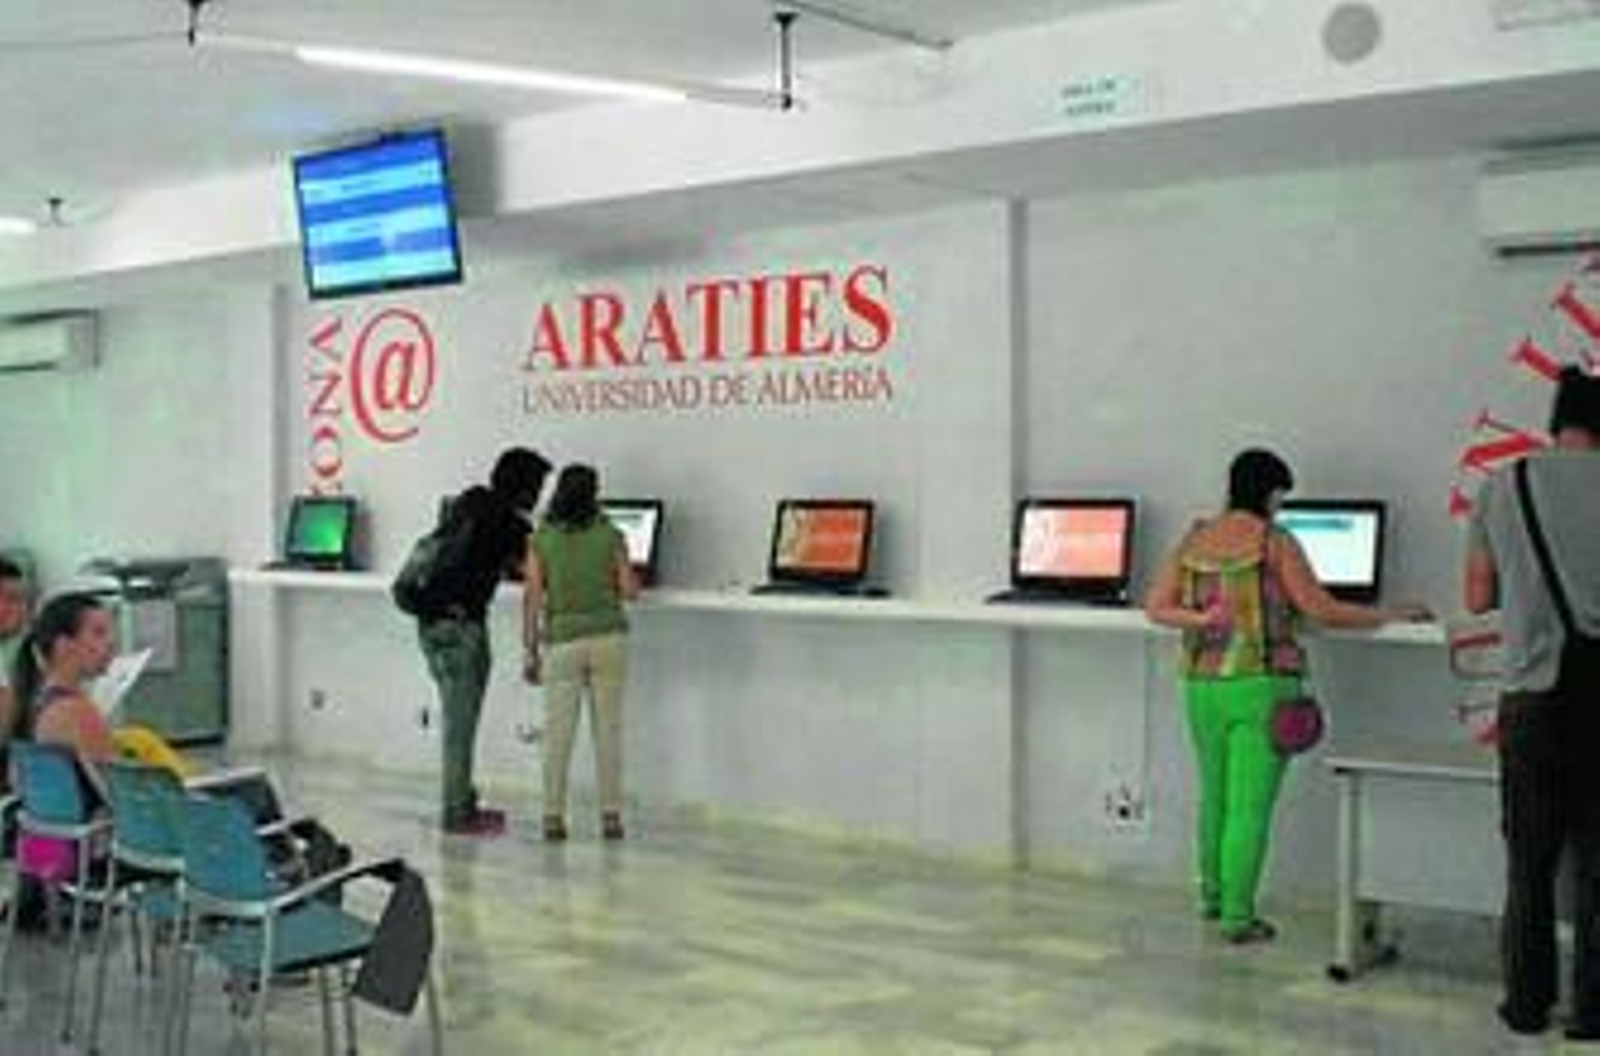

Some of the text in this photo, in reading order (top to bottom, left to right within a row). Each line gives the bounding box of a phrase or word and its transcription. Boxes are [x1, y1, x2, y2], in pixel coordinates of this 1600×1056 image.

[522, 264, 894, 373] ARATIES
[522, 376, 701, 415] UNIVERSIDAD
[707, 374, 751, 406] DE
